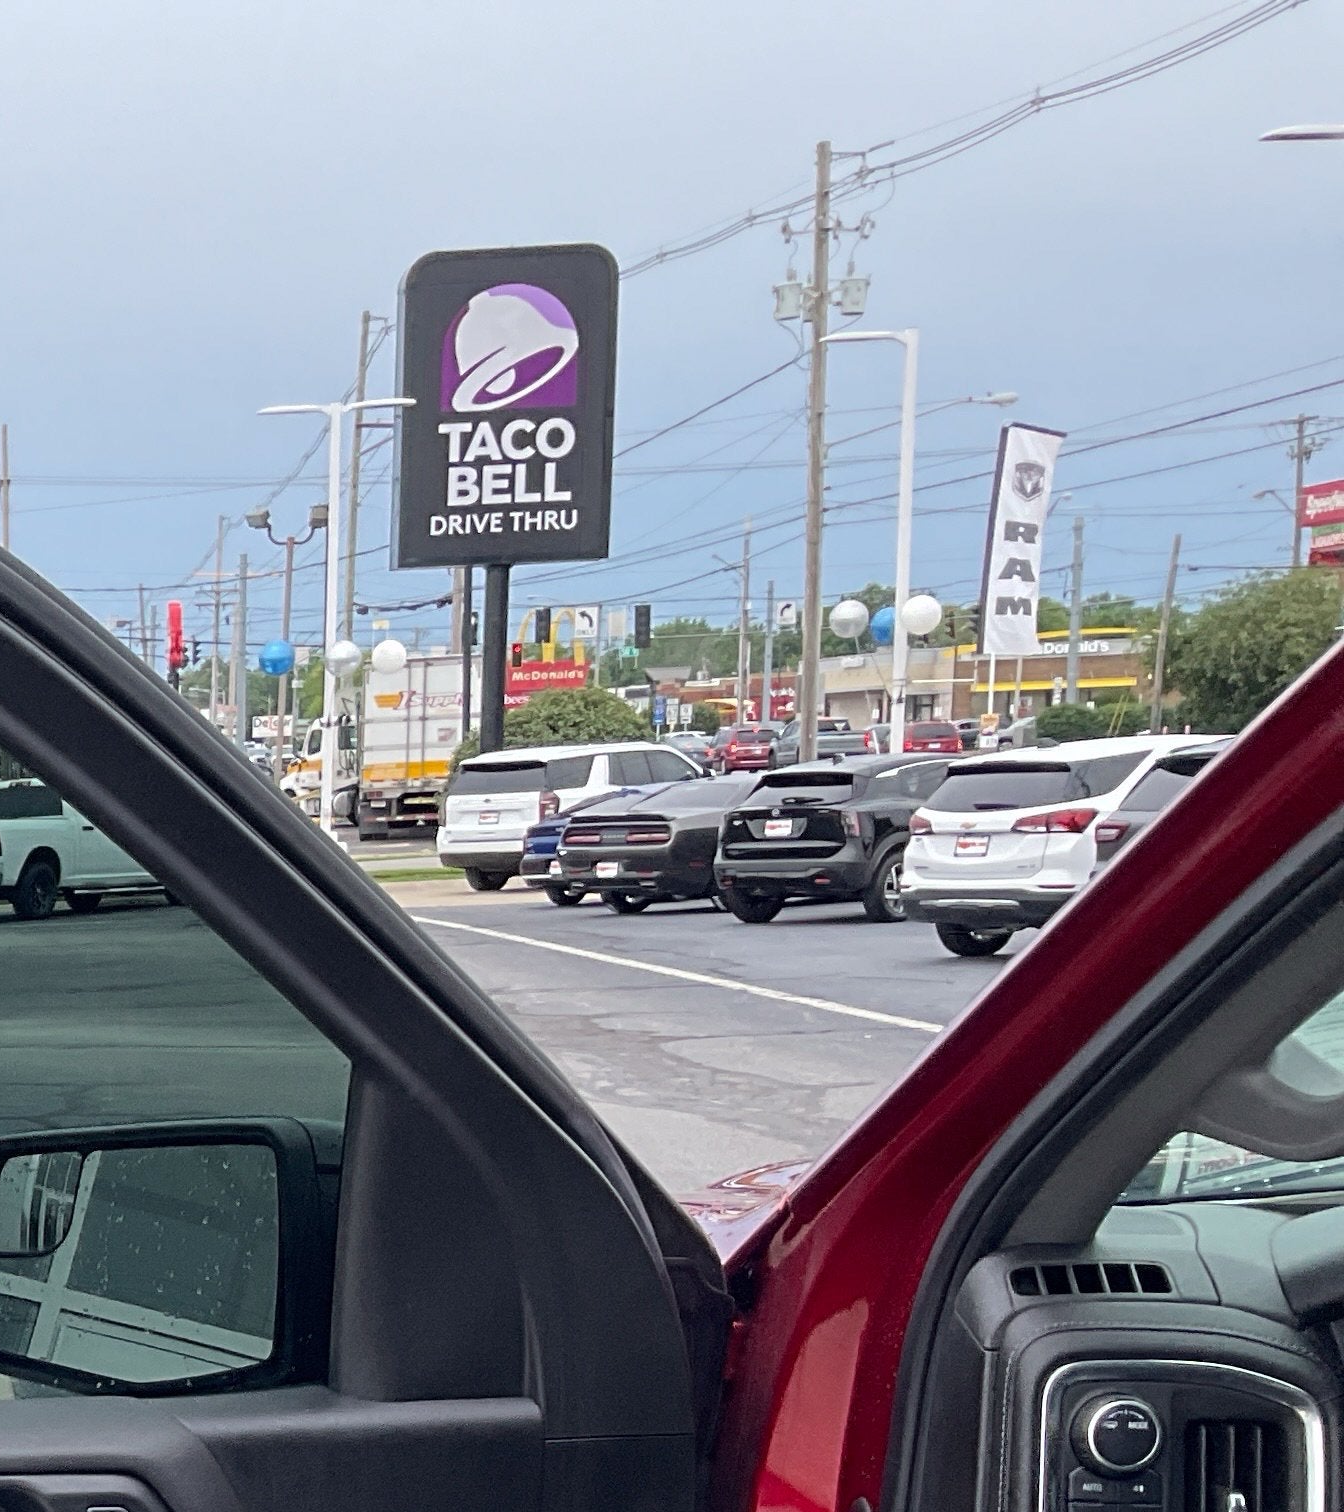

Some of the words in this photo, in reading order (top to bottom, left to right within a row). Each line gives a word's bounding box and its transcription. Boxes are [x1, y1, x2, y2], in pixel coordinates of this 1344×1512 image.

[438, 418, 576, 462] TACO
[447, 462, 572, 506] BELL
[429, 513, 502, 537] DRIVE
[510, 509, 578, 531] THRU
[995, 520, 1039, 617] RAM
[512, 669, 584, 681] McDonald's
